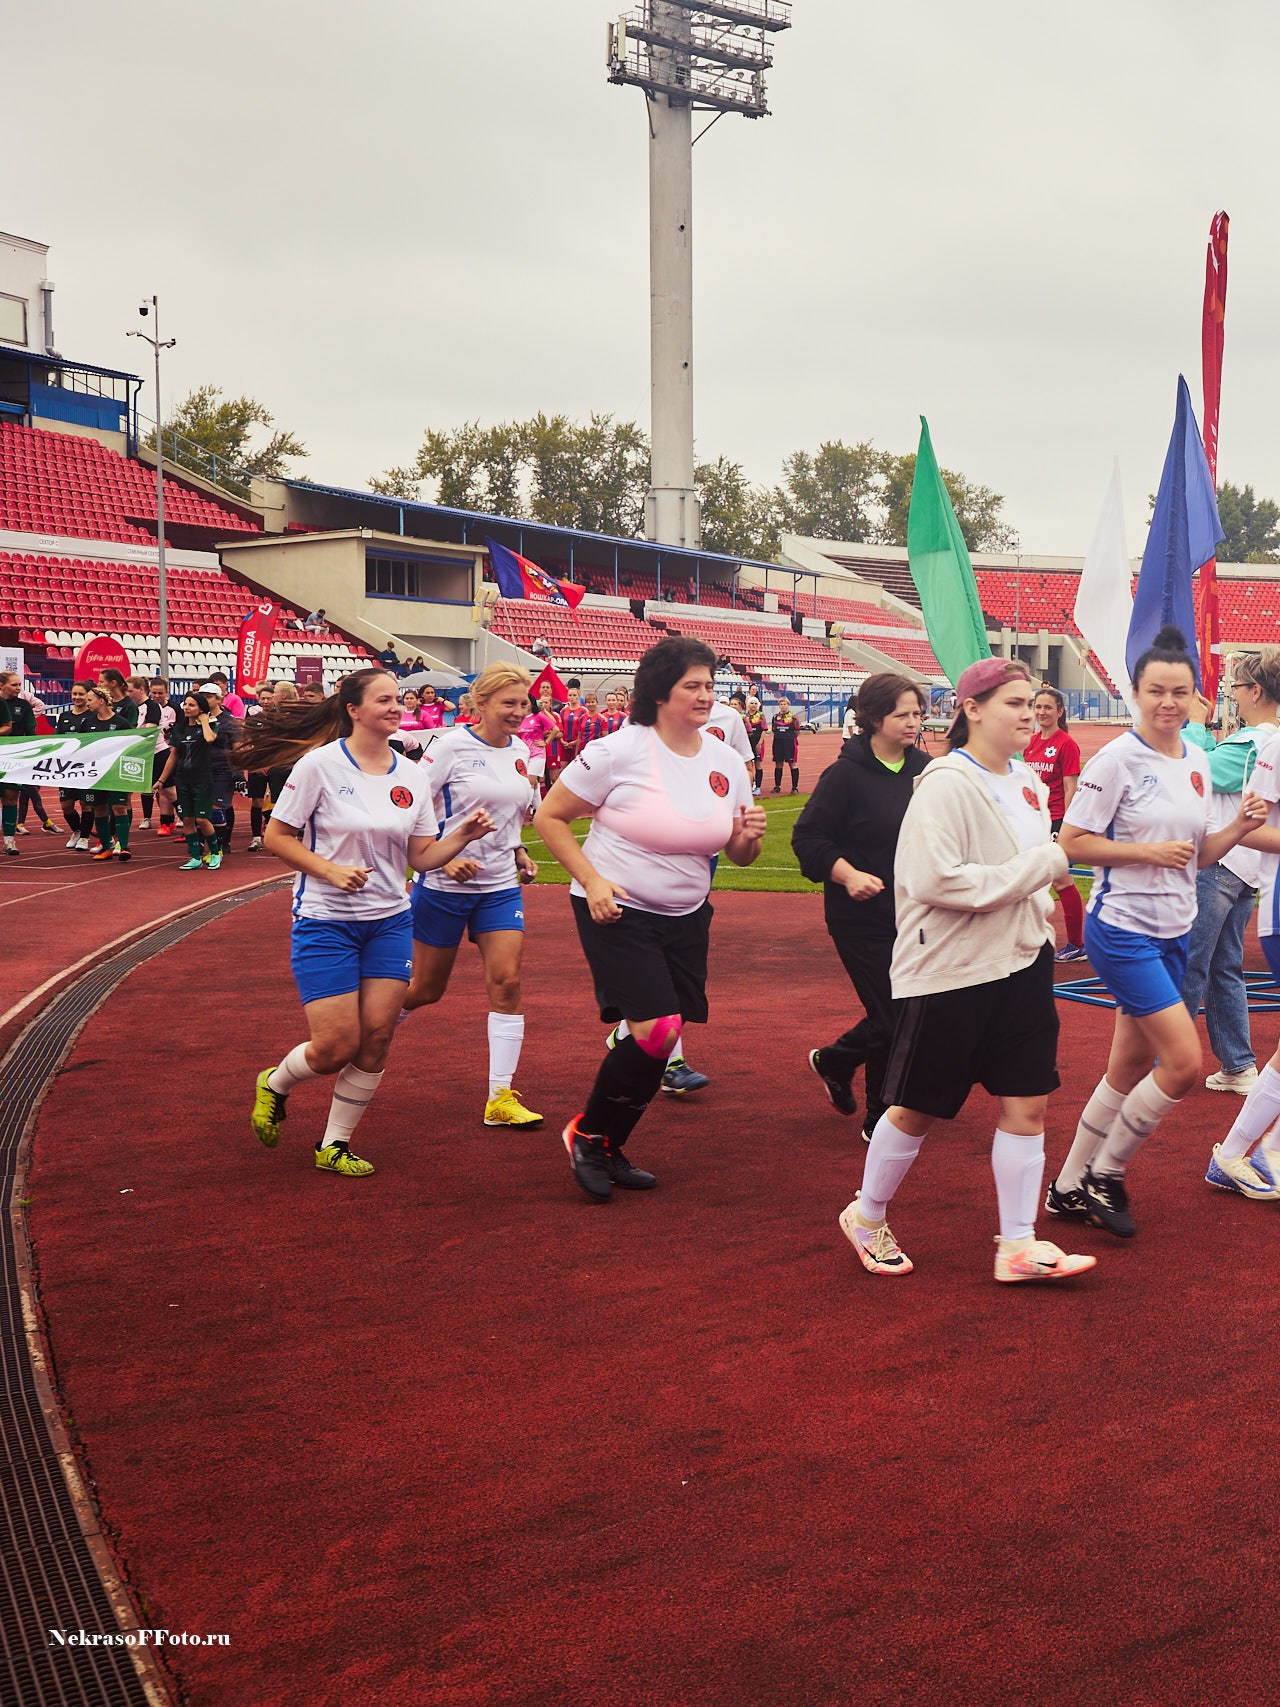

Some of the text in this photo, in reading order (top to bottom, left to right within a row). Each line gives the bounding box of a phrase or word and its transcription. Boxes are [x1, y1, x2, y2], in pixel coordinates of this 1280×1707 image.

[242, 630, 257, 677] ОСНОВА
[32, 769, 98, 780] moms
[85, 794, 95, 802] 88
